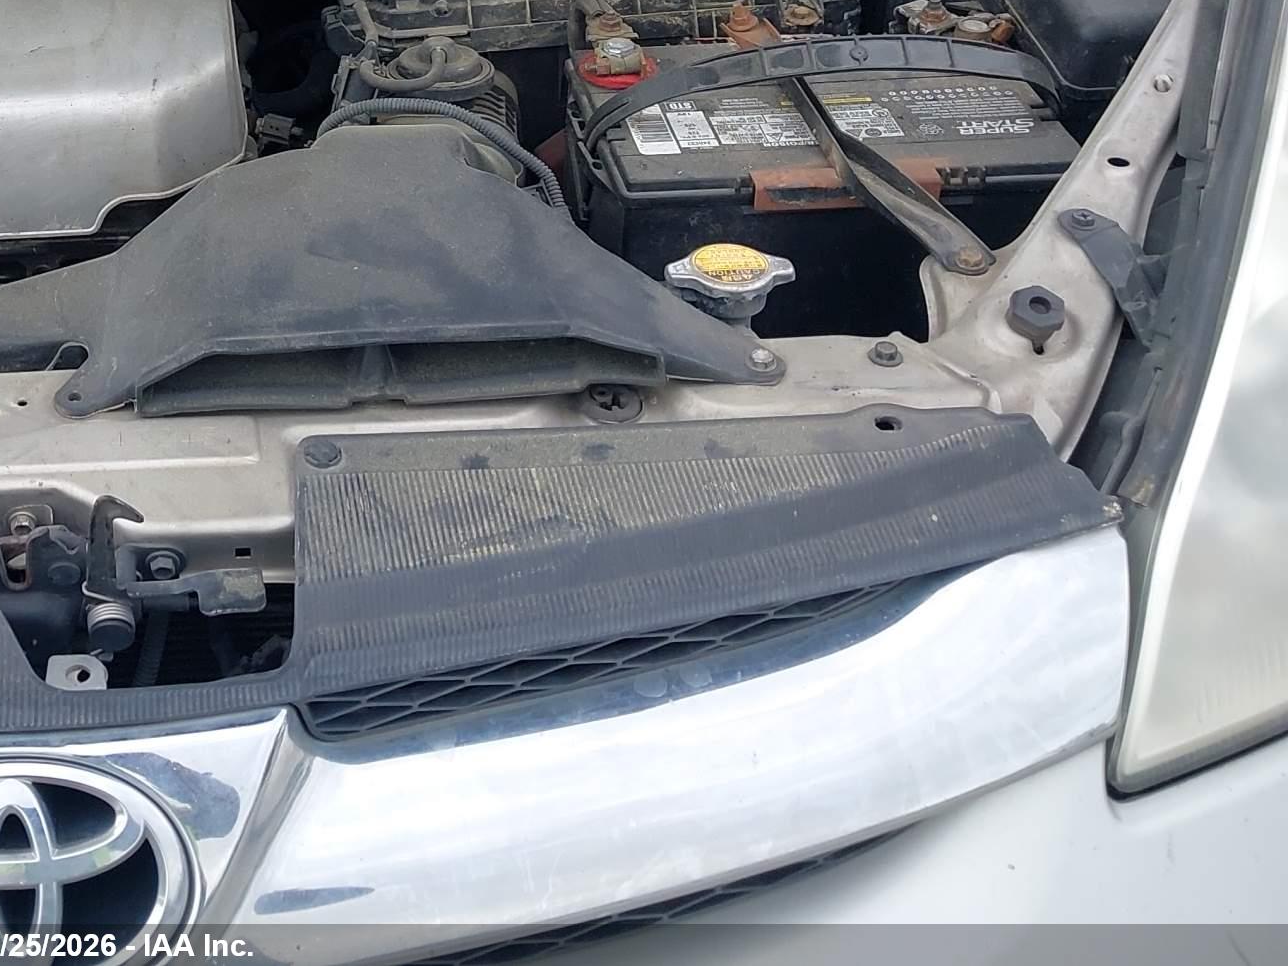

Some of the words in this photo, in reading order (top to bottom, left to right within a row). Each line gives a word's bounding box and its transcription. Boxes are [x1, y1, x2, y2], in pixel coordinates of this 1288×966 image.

[956, 118, 1034, 130] START
[959, 126, 1031, 135] SUPER
[708, 268, 761, 276] CAUTION
